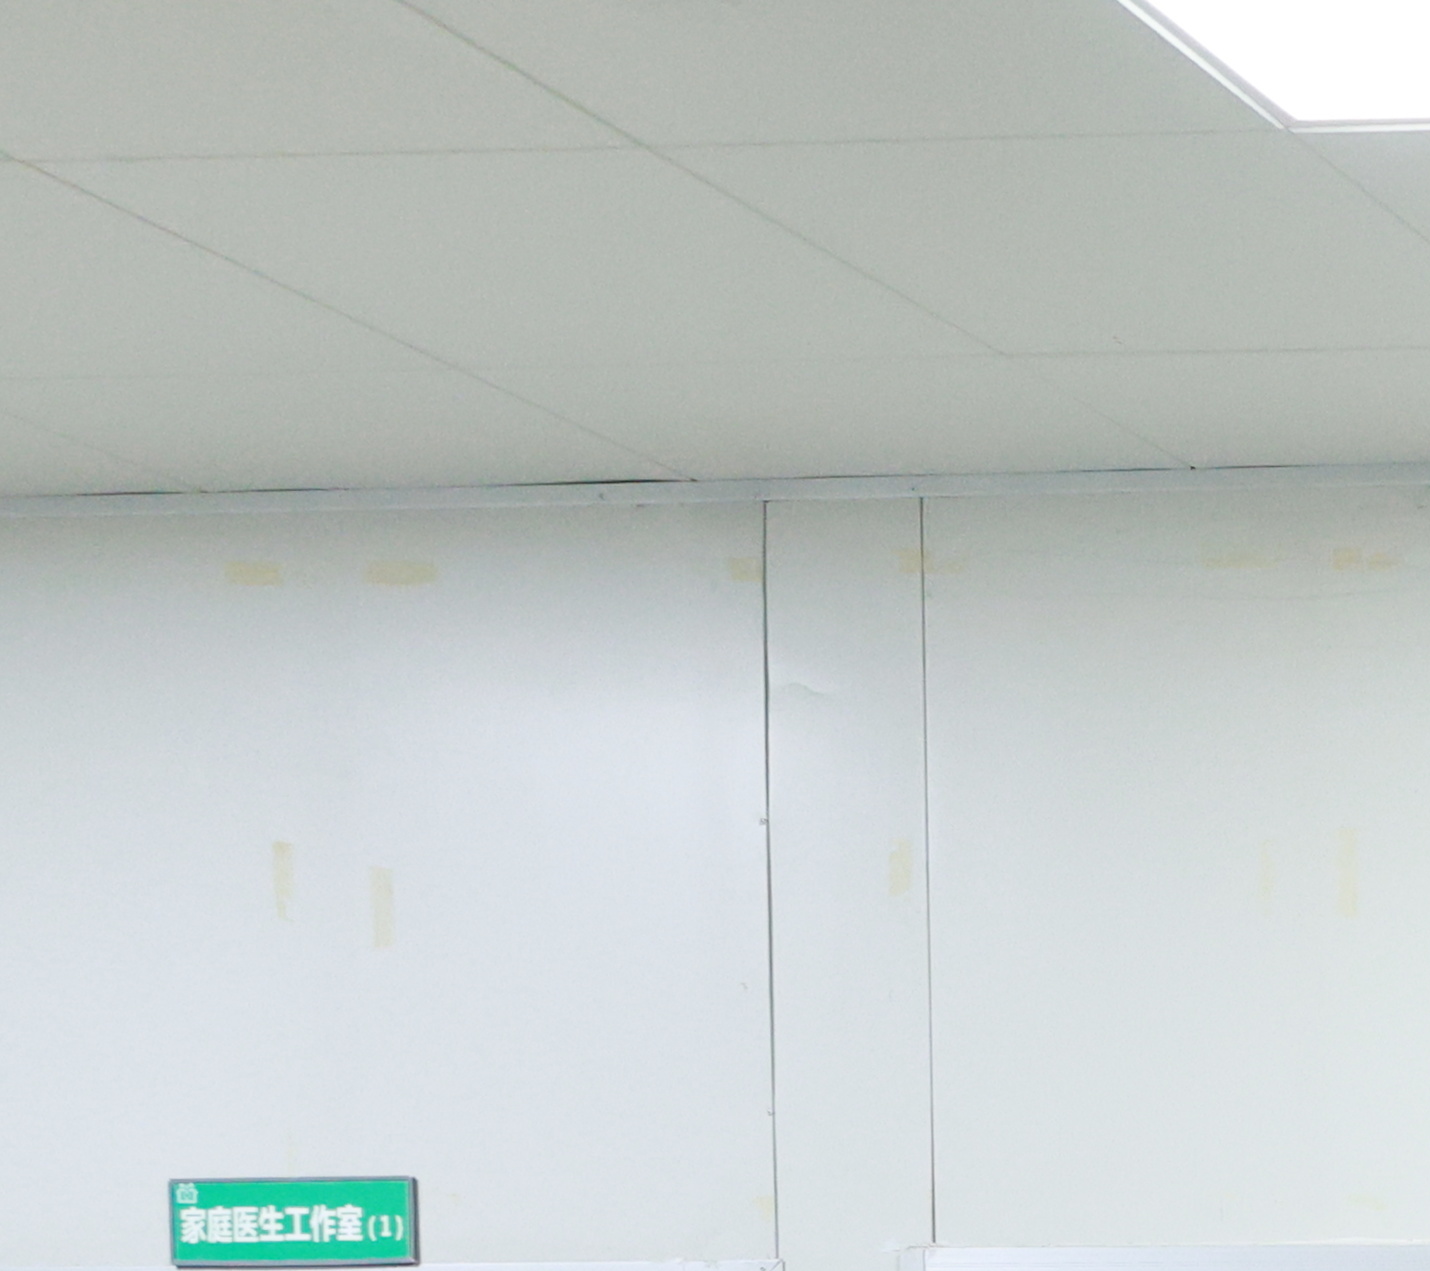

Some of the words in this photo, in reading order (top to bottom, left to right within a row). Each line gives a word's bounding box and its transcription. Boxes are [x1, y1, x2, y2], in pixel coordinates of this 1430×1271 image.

[179, 1204, 404, 1244] 家庭医生工作室(1)
